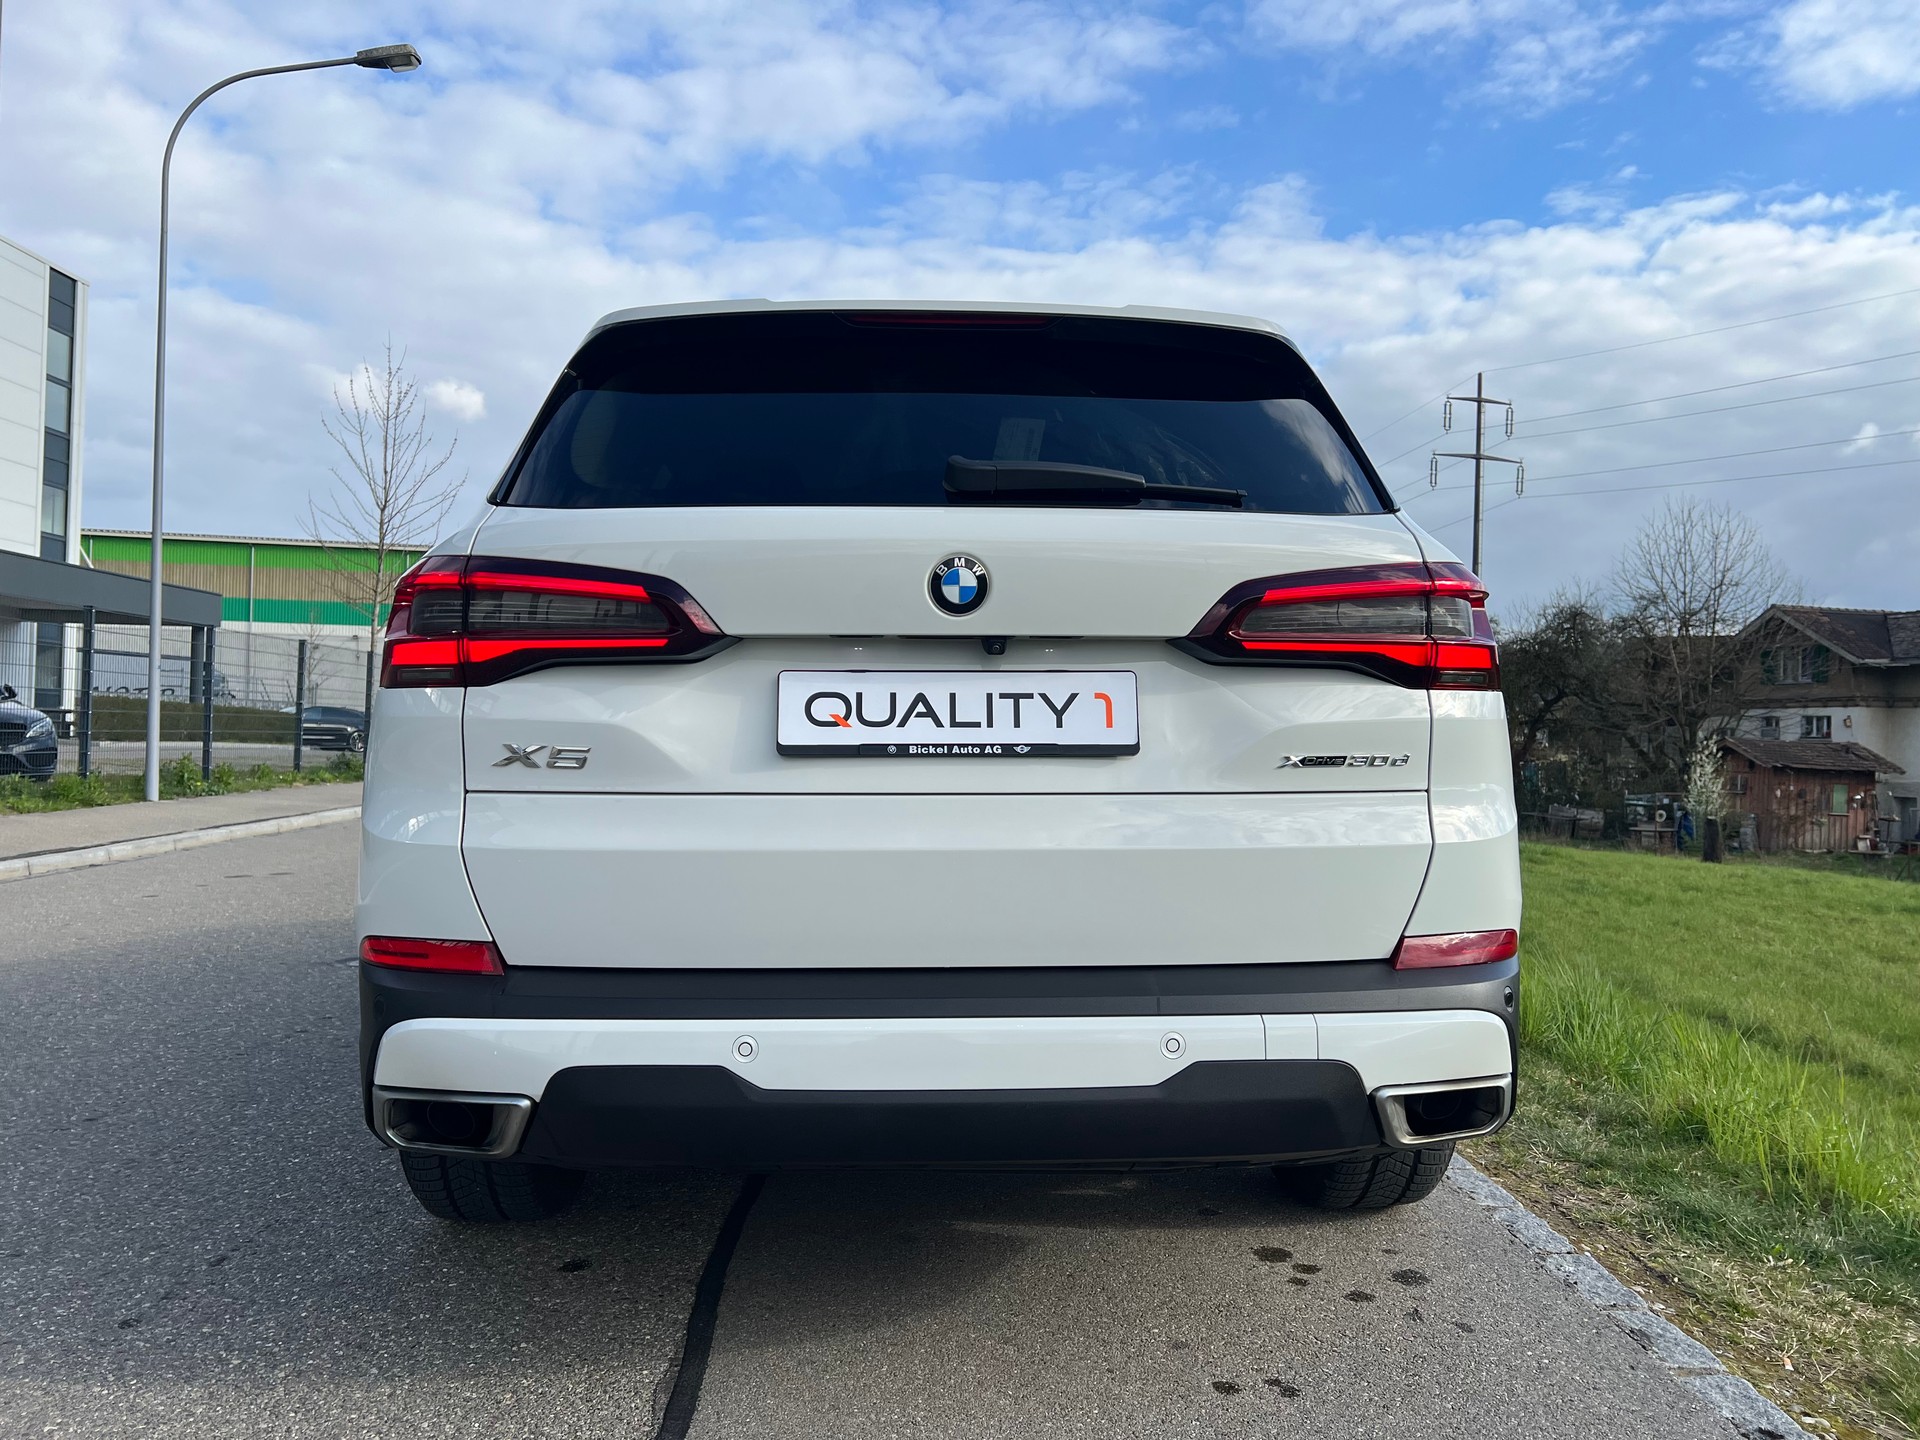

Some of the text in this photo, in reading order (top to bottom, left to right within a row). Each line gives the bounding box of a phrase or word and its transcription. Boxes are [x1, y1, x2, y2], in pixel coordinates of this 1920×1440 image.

[935, 557, 985, 576] BMW
[804, 691, 1080, 729] QUALITY
[490, 743, 592, 770] X5
[908, 745, 1002, 754] Bickel Auto AG
